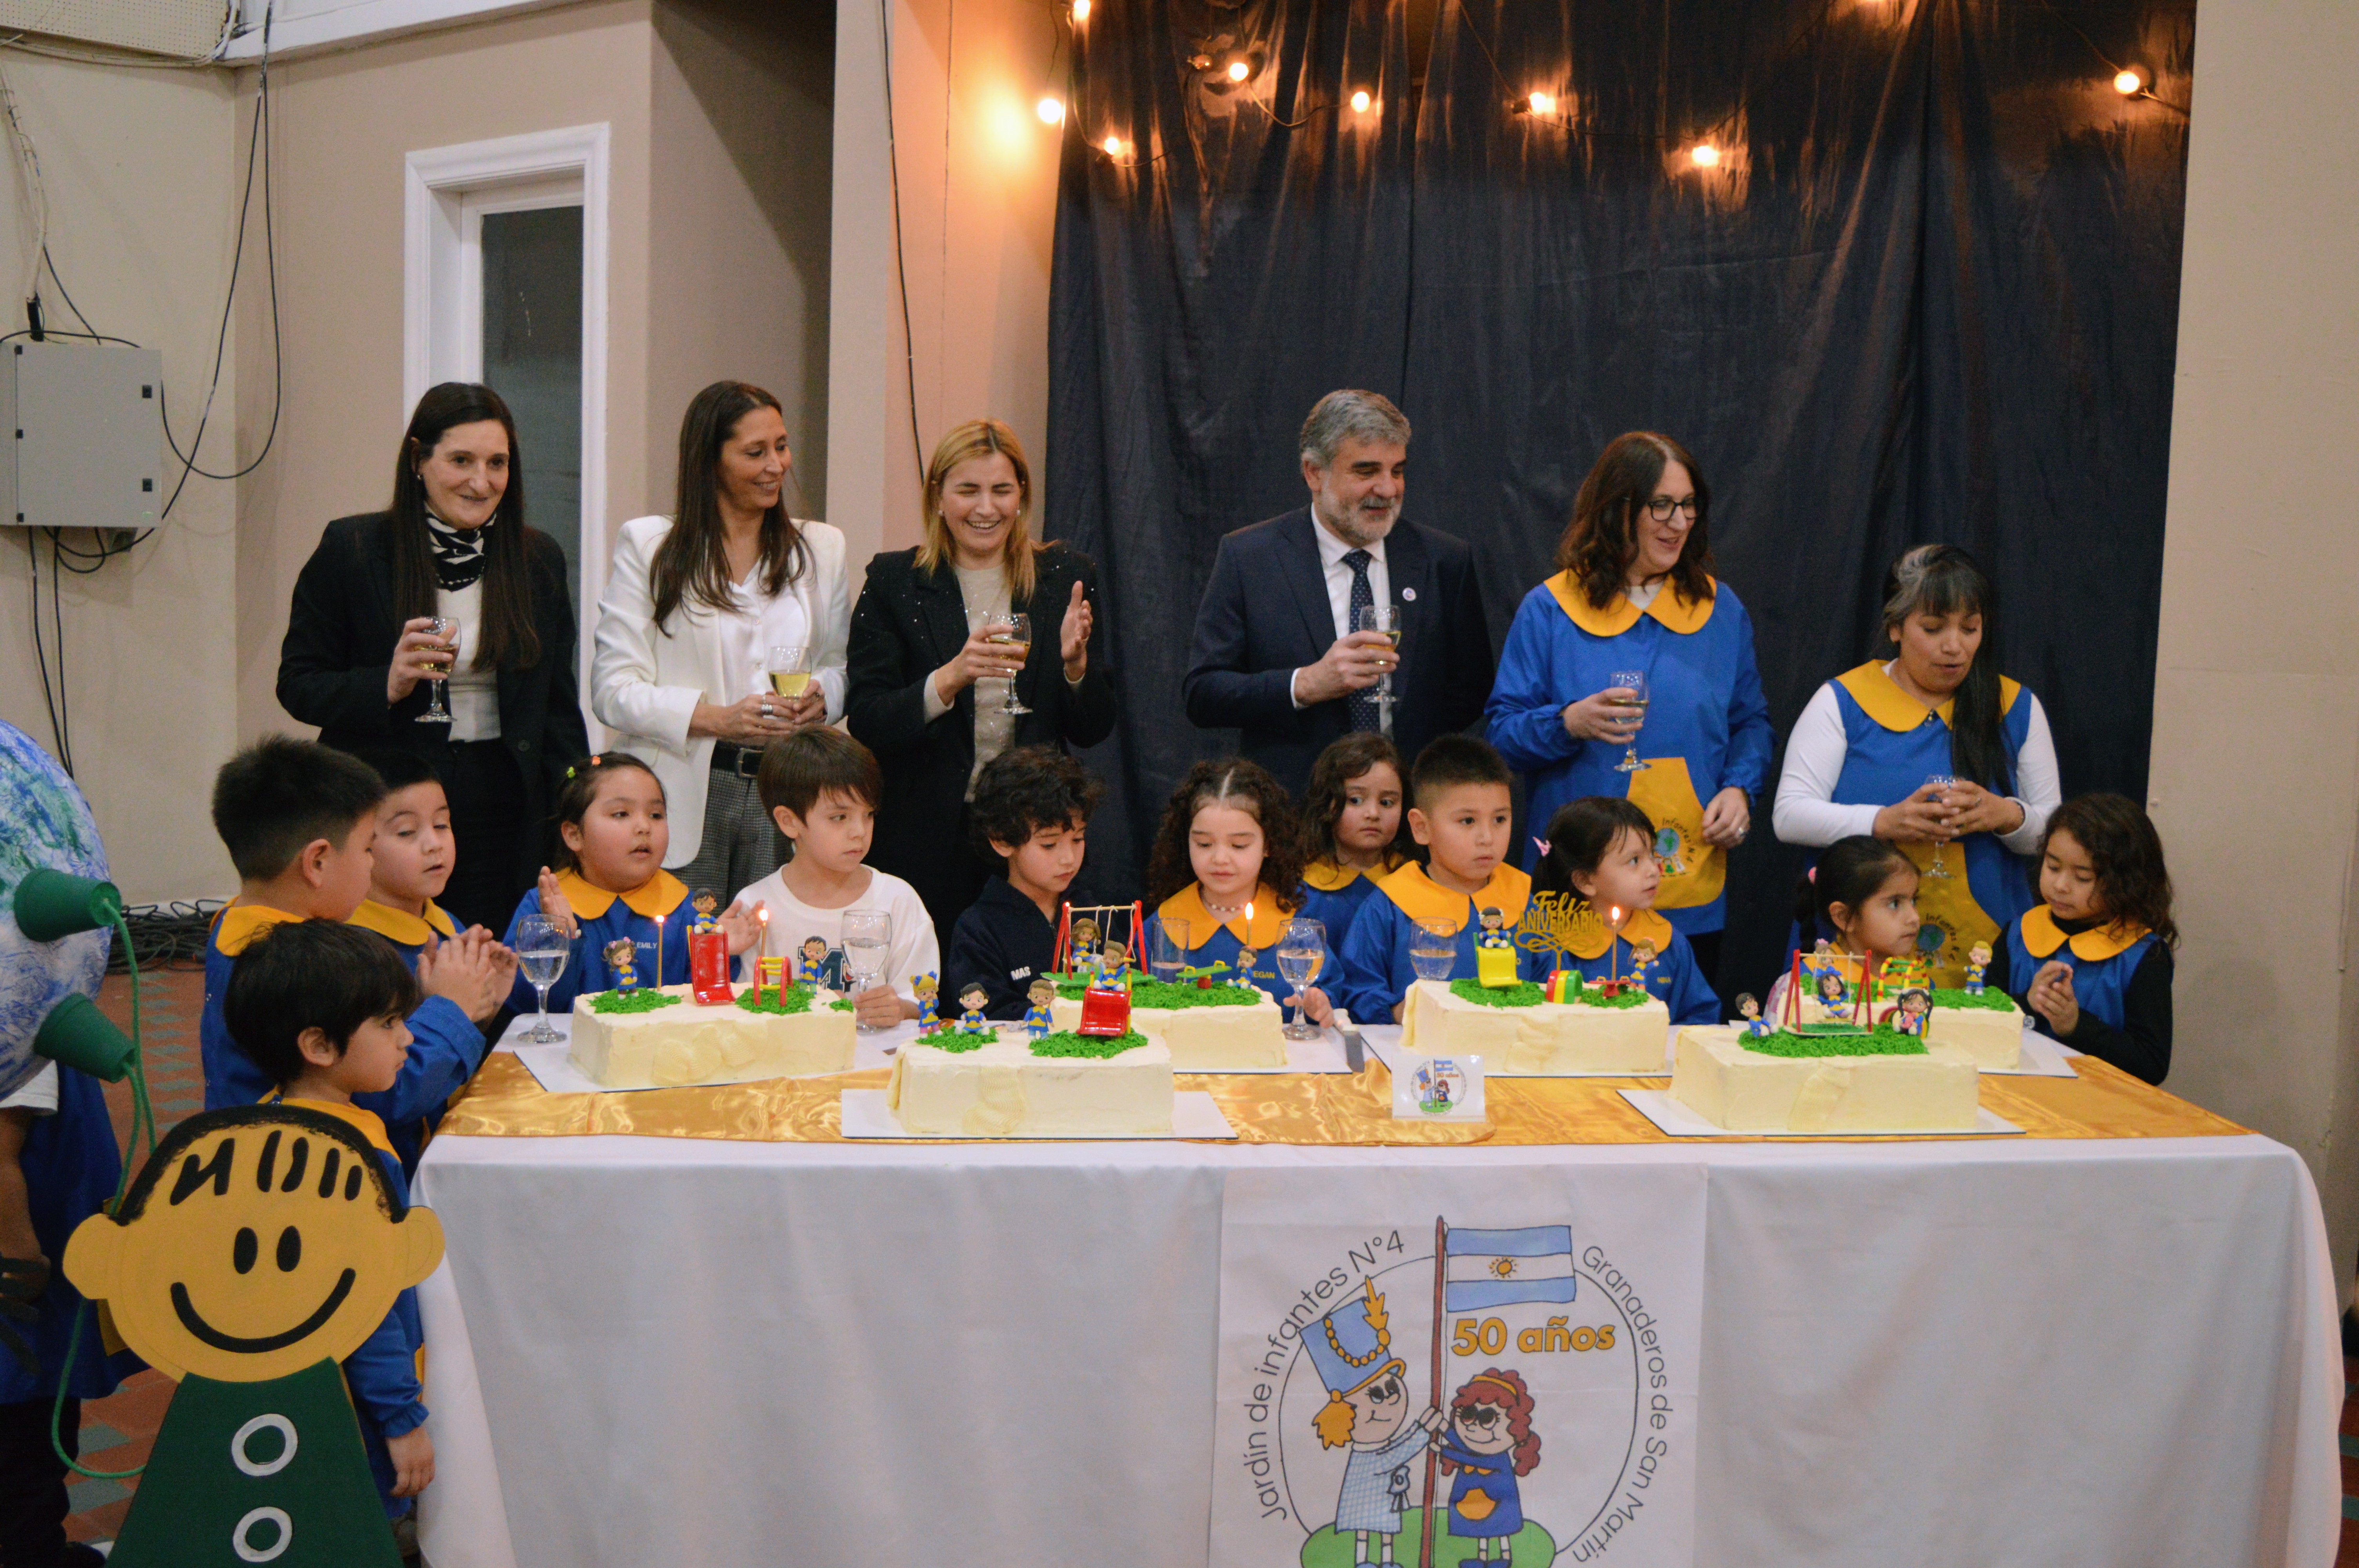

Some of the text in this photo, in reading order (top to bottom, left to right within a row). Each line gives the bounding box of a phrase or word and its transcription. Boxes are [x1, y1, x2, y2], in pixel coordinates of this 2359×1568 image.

[1517, 910, 1604, 933] ANIVERSARIO
[1530, 890, 1590, 913] Feliz
[798, 946, 851, 993] M
[1254, 1267, 1348, 1376] infantes
[1451, 1315, 1616, 1356] 50 años
[1243, 1383, 1272, 1422] de
[1572, 1246, 1674, 1563] Granaderos de San Martín
[1243, 1432, 1287, 1520] Jardín
